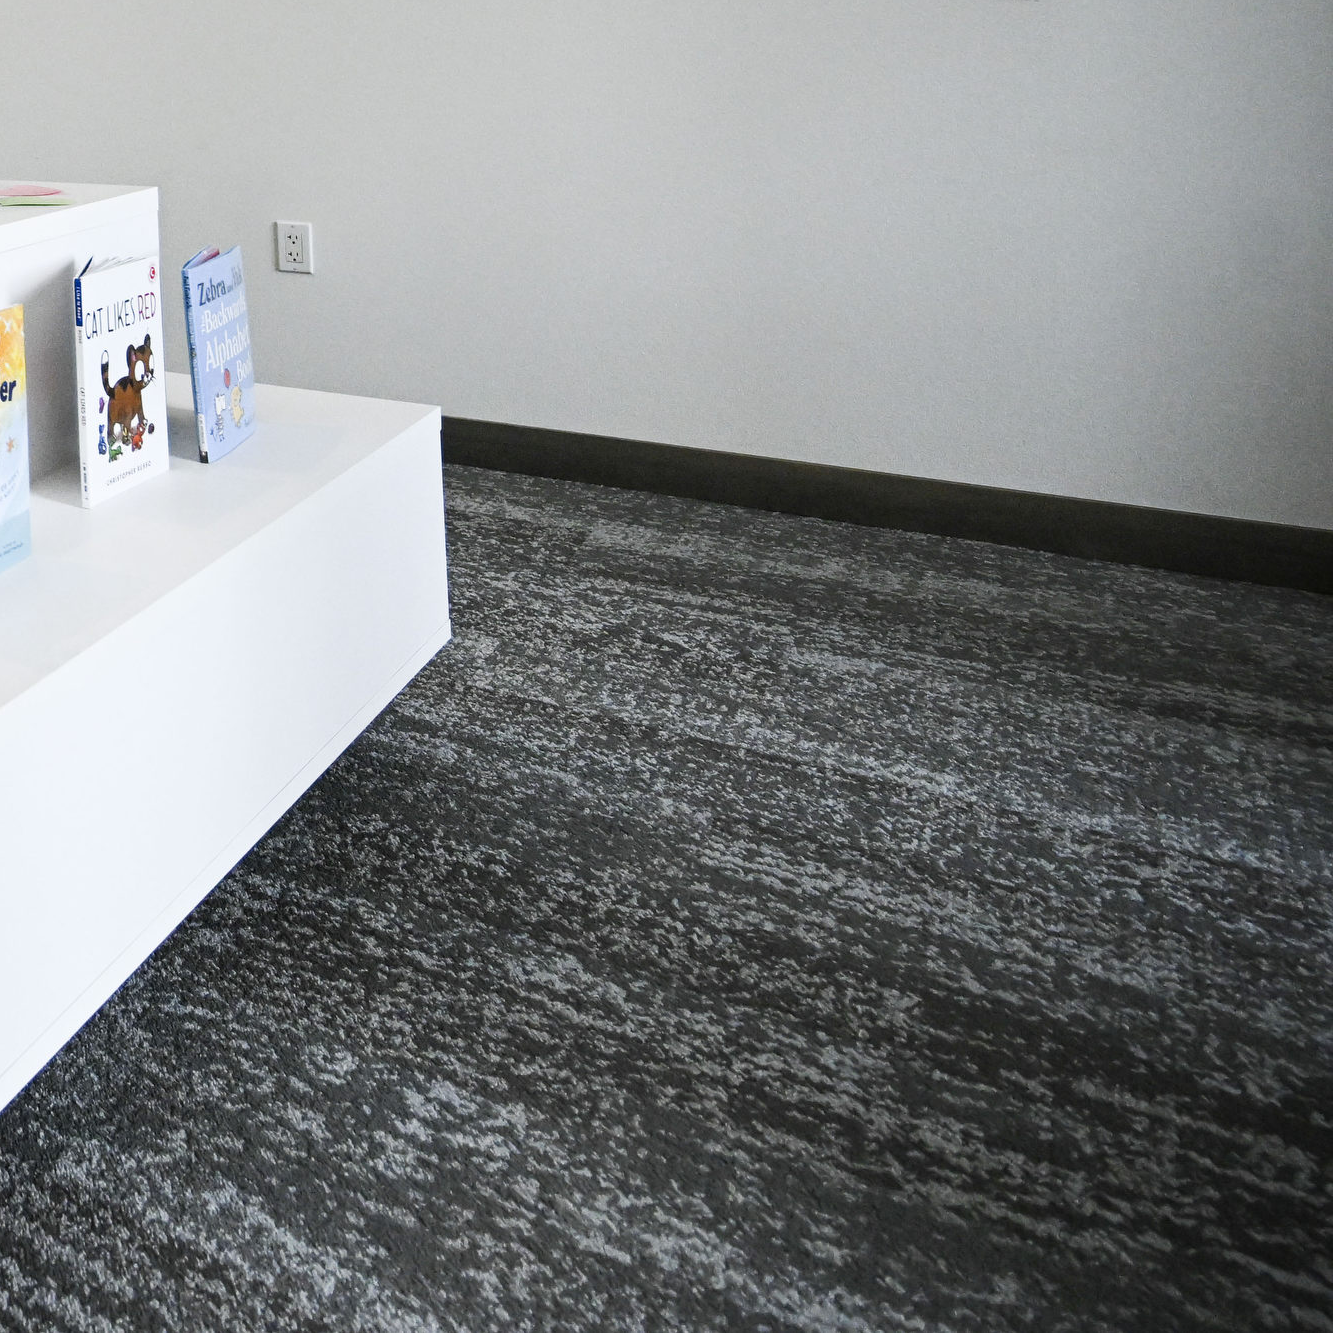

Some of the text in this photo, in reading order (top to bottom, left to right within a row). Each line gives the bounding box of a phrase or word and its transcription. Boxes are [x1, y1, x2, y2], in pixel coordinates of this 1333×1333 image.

[197, 277, 227, 306] Zebra
[85, 291, 157, 340] CAT LIKES RED
